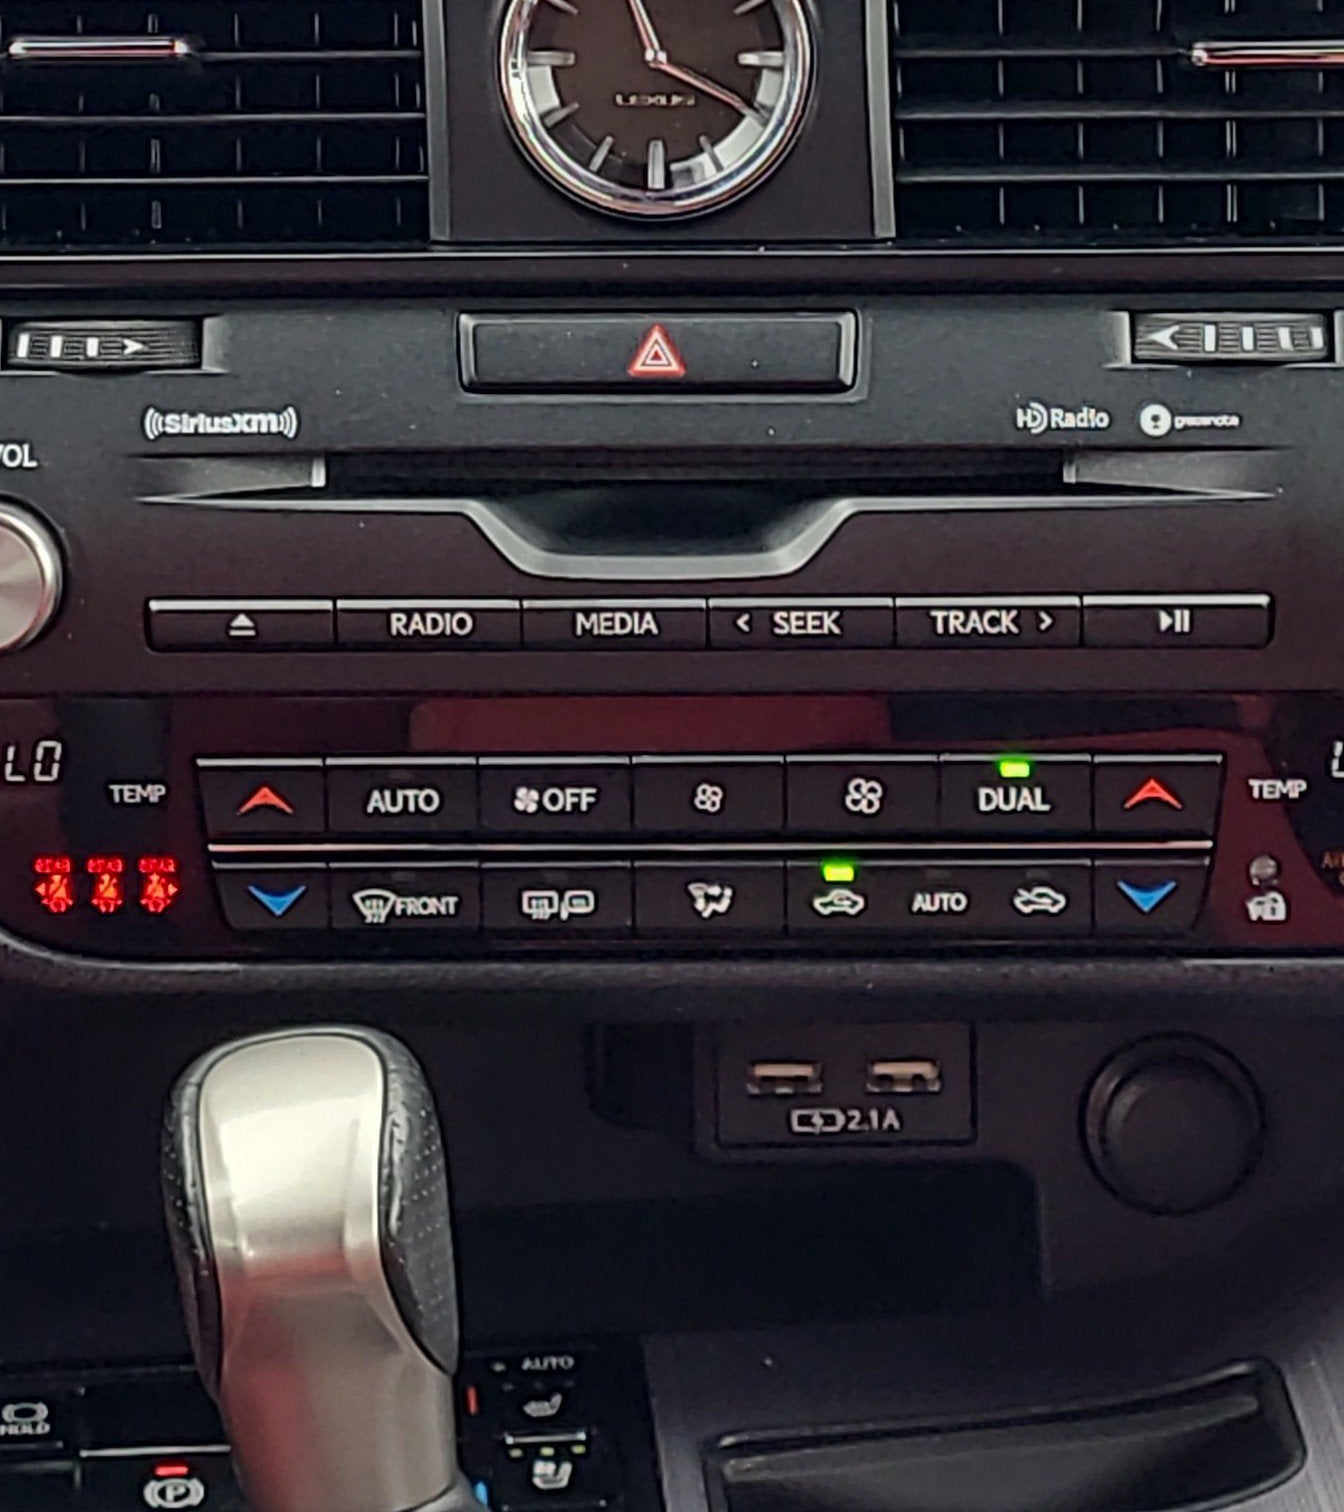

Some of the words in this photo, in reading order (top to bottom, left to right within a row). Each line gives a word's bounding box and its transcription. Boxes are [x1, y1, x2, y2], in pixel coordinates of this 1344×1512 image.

[1049, 406, 1110, 429] Radio
[390, 611, 473, 636] RADIO
[576, 611, 659, 636] MEDIA
[773, 610, 841, 635] SEEK
[929, 609, 1019, 634] TRACK
[4, 740, 62, 782] LO
[108, 783, 166, 804] TEMP
[366, 788, 440, 814] AUTO
[542, 787, 597, 812] OFF
[978, 786, 1051, 812] DUAL
[1248, 778, 1308, 800] TEMP
[395, 895, 459, 916] FRONT
[911, 892, 968, 912] AUTO
[847, 1108, 900, 1131] 2.1A
[521, 1355, 575, 1371] AUTO
